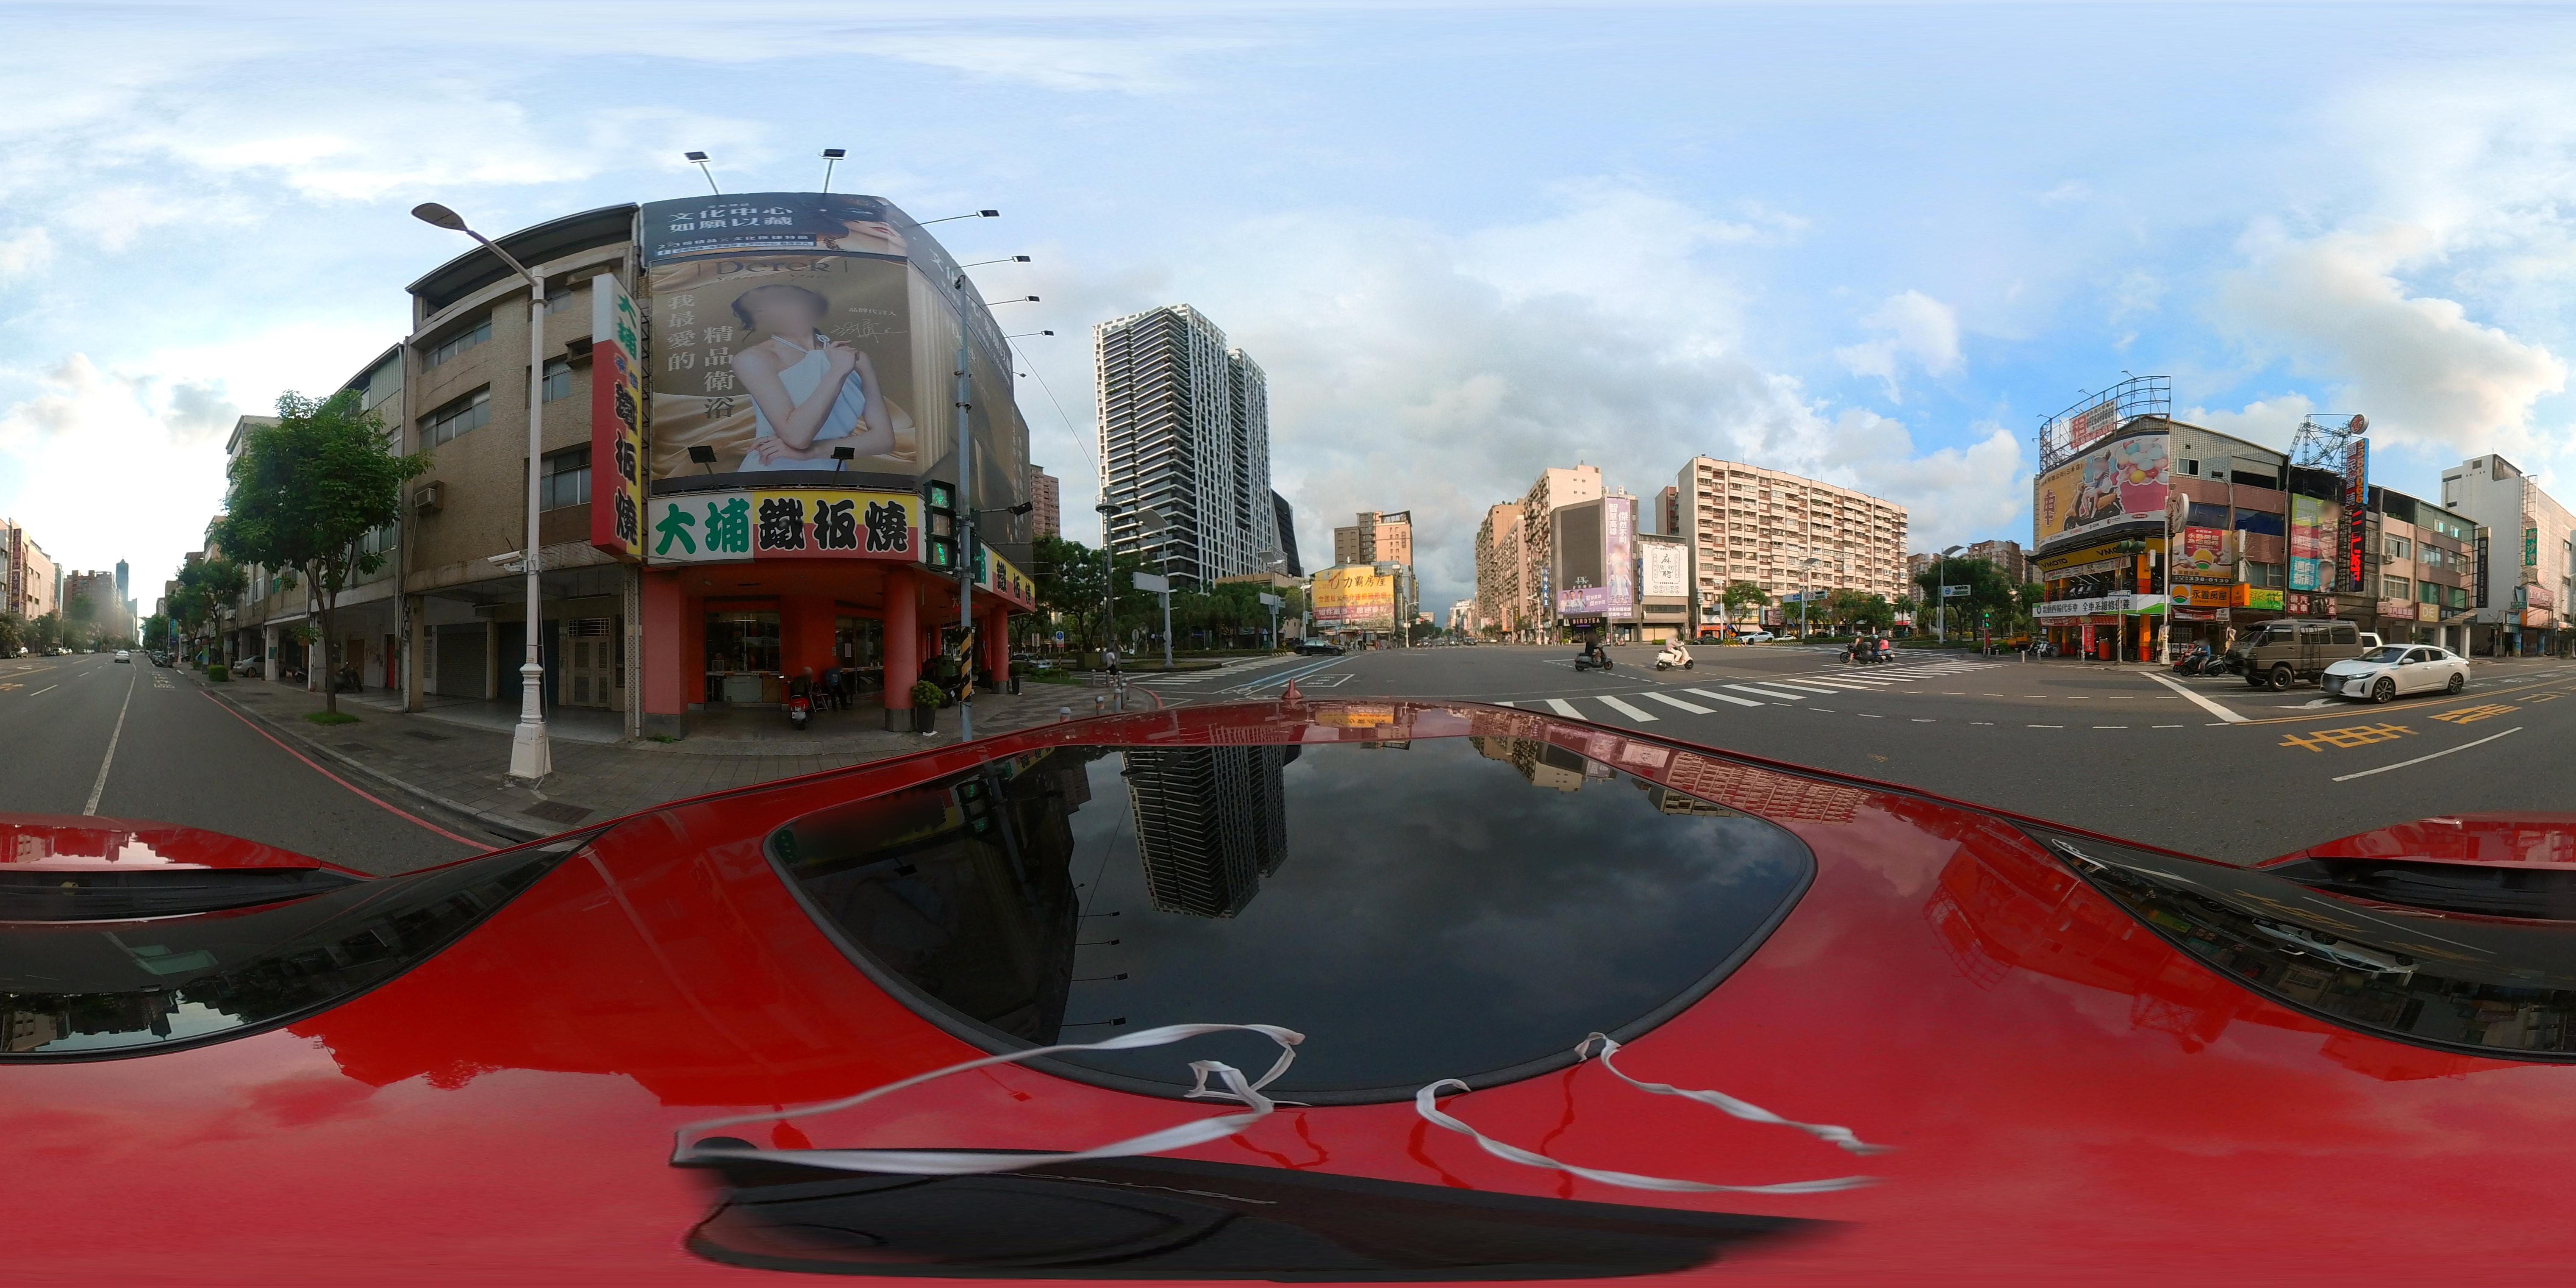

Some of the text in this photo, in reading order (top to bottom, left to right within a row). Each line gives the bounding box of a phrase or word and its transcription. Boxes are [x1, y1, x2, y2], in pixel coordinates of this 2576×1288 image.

[668, 207, 794, 222] 文化中心
[668, 217, 794, 233] 如願以藏
[714, 259, 831, 275] Derek
[929, 248, 981, 319] 文化心
[667, 294, 696, 372] 我最愛的
[702, 325, 734, 419] 精品衛浴
[615, 379, 638, 547] 鐵板燒
[2356, 439, 2365, 503] 3380066
[655, 496, 910, 555] 大埔鐵板燒
[1608, 503, 1618, 535] 智慧高雄
[1618, 511, 1628, 544] 傑然不同
[2040, 558, 2068, 569] VMOTO
[1343, 575, 1386, 588] 力霸房屋
[2192, 589, 2227, 600] 永義房屋
[2082, 598, 2130, 613] 全車系維修保養
[2300, 595, 2308, 612] 汽車
[2422, 607, 2434, 617] DE
